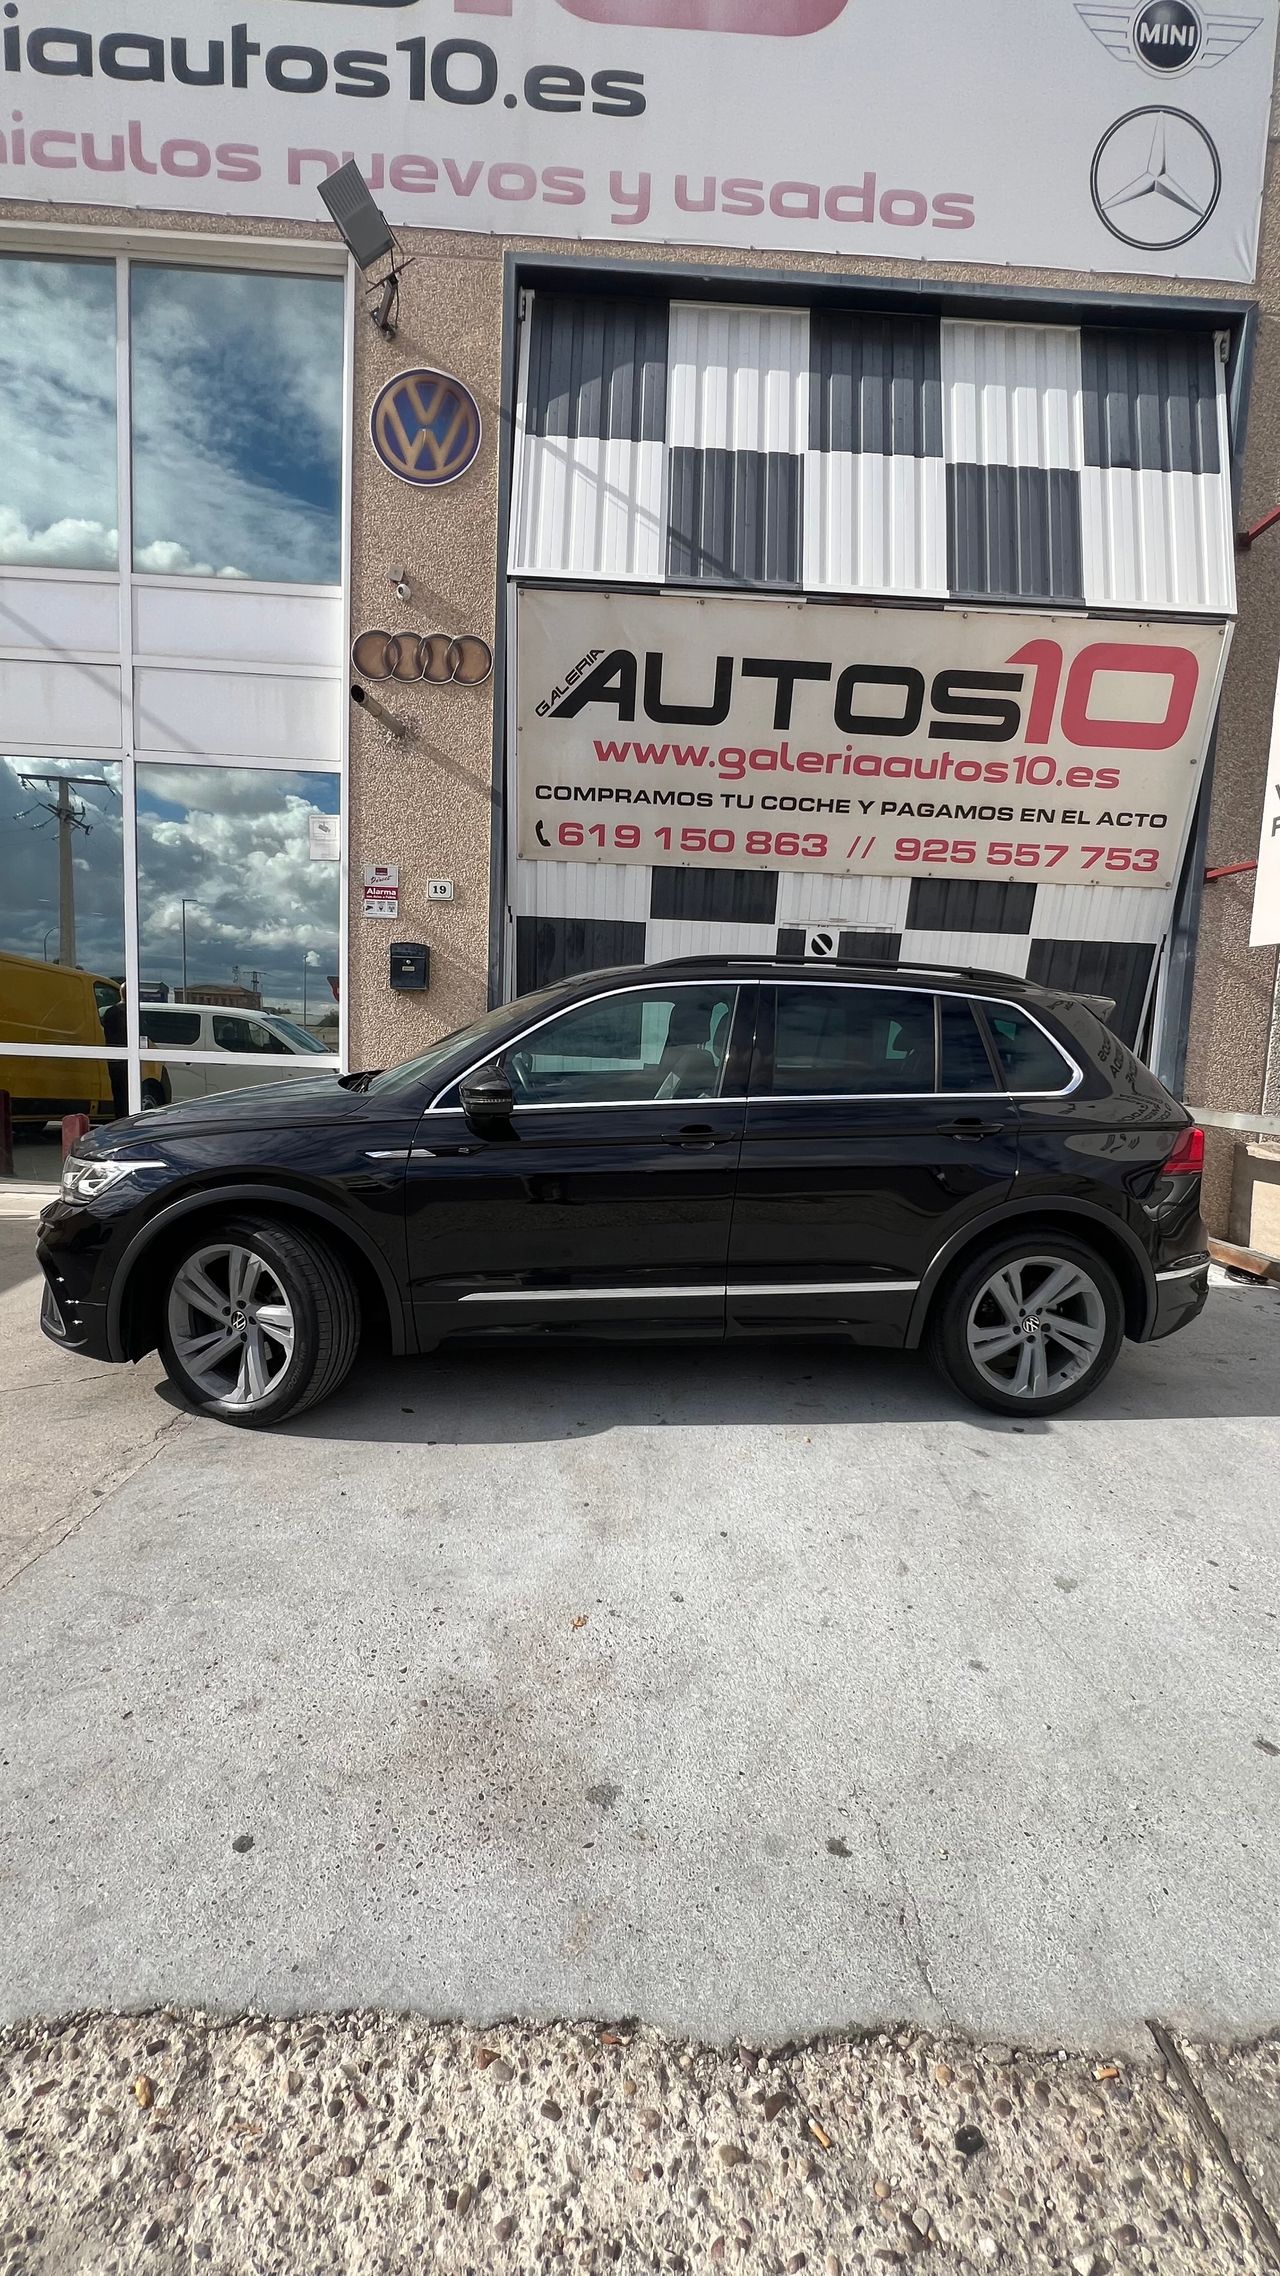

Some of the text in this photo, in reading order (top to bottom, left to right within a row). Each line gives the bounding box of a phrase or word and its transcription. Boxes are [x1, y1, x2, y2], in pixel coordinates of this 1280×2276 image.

[1140, 22, 1195, 47] MINI
[0, 109, 260, 182] iculos
[609, 172, 651, 224] y
[674, 172, 975, 230] usados
[534, 649, 605, 717] GALERIA
[547, 637, 1200, 753] AUTOS10
[592, 740, 1121, 791] www.galeriaautos10.es
[535, 784, 1168, 829] COMPRAMOS TU COCHE Y PAGAMOS EN EL ACTO
[557, 820, 642, 849] 619
[655, 826, 736, 854] 150
[744, 830, 829, 859] 863
[894, 836, 977, 865] 925
[986, 840, 1070, 868] 557
[1080, 845, 1161, 873] 753
[366, 887, 397, 896] Alarma
[432, 885, 447, 895] 19
